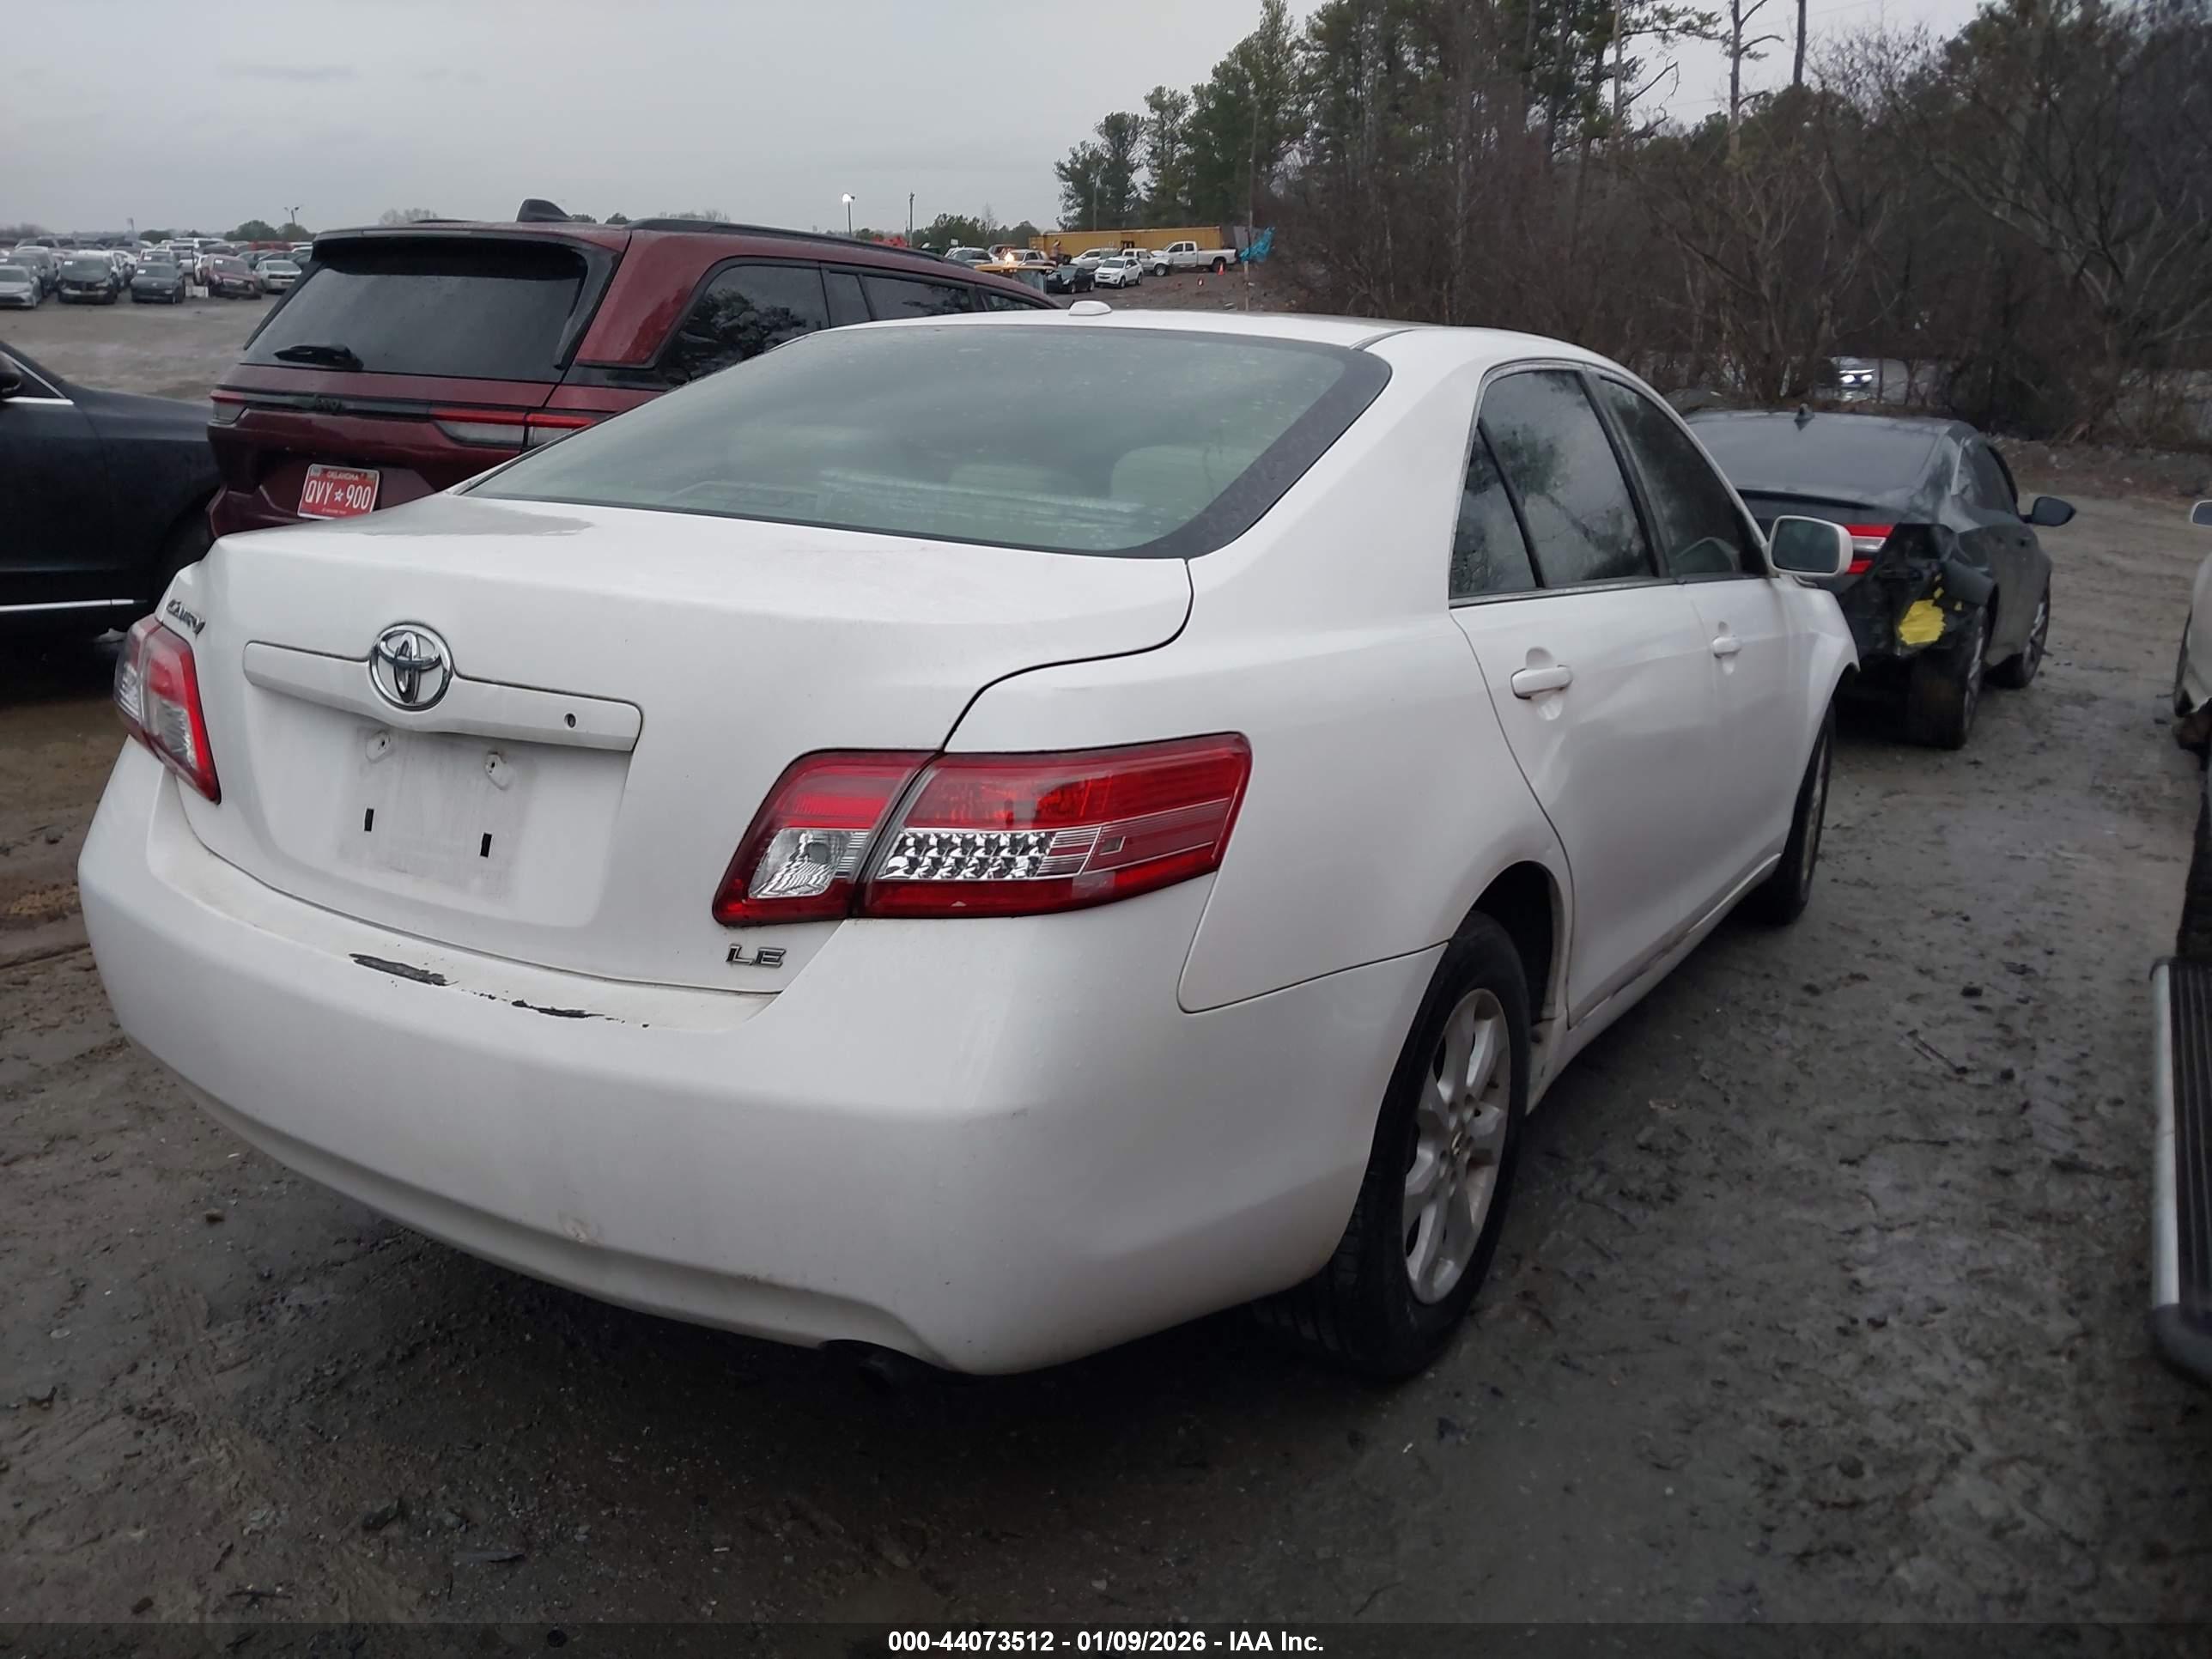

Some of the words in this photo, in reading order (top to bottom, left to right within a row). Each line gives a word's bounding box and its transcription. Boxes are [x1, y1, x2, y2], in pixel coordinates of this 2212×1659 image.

[305, 480, 333, 505] QVY
[345, 484, 371, 509] 900
[726, 945, 787, 968] LE
